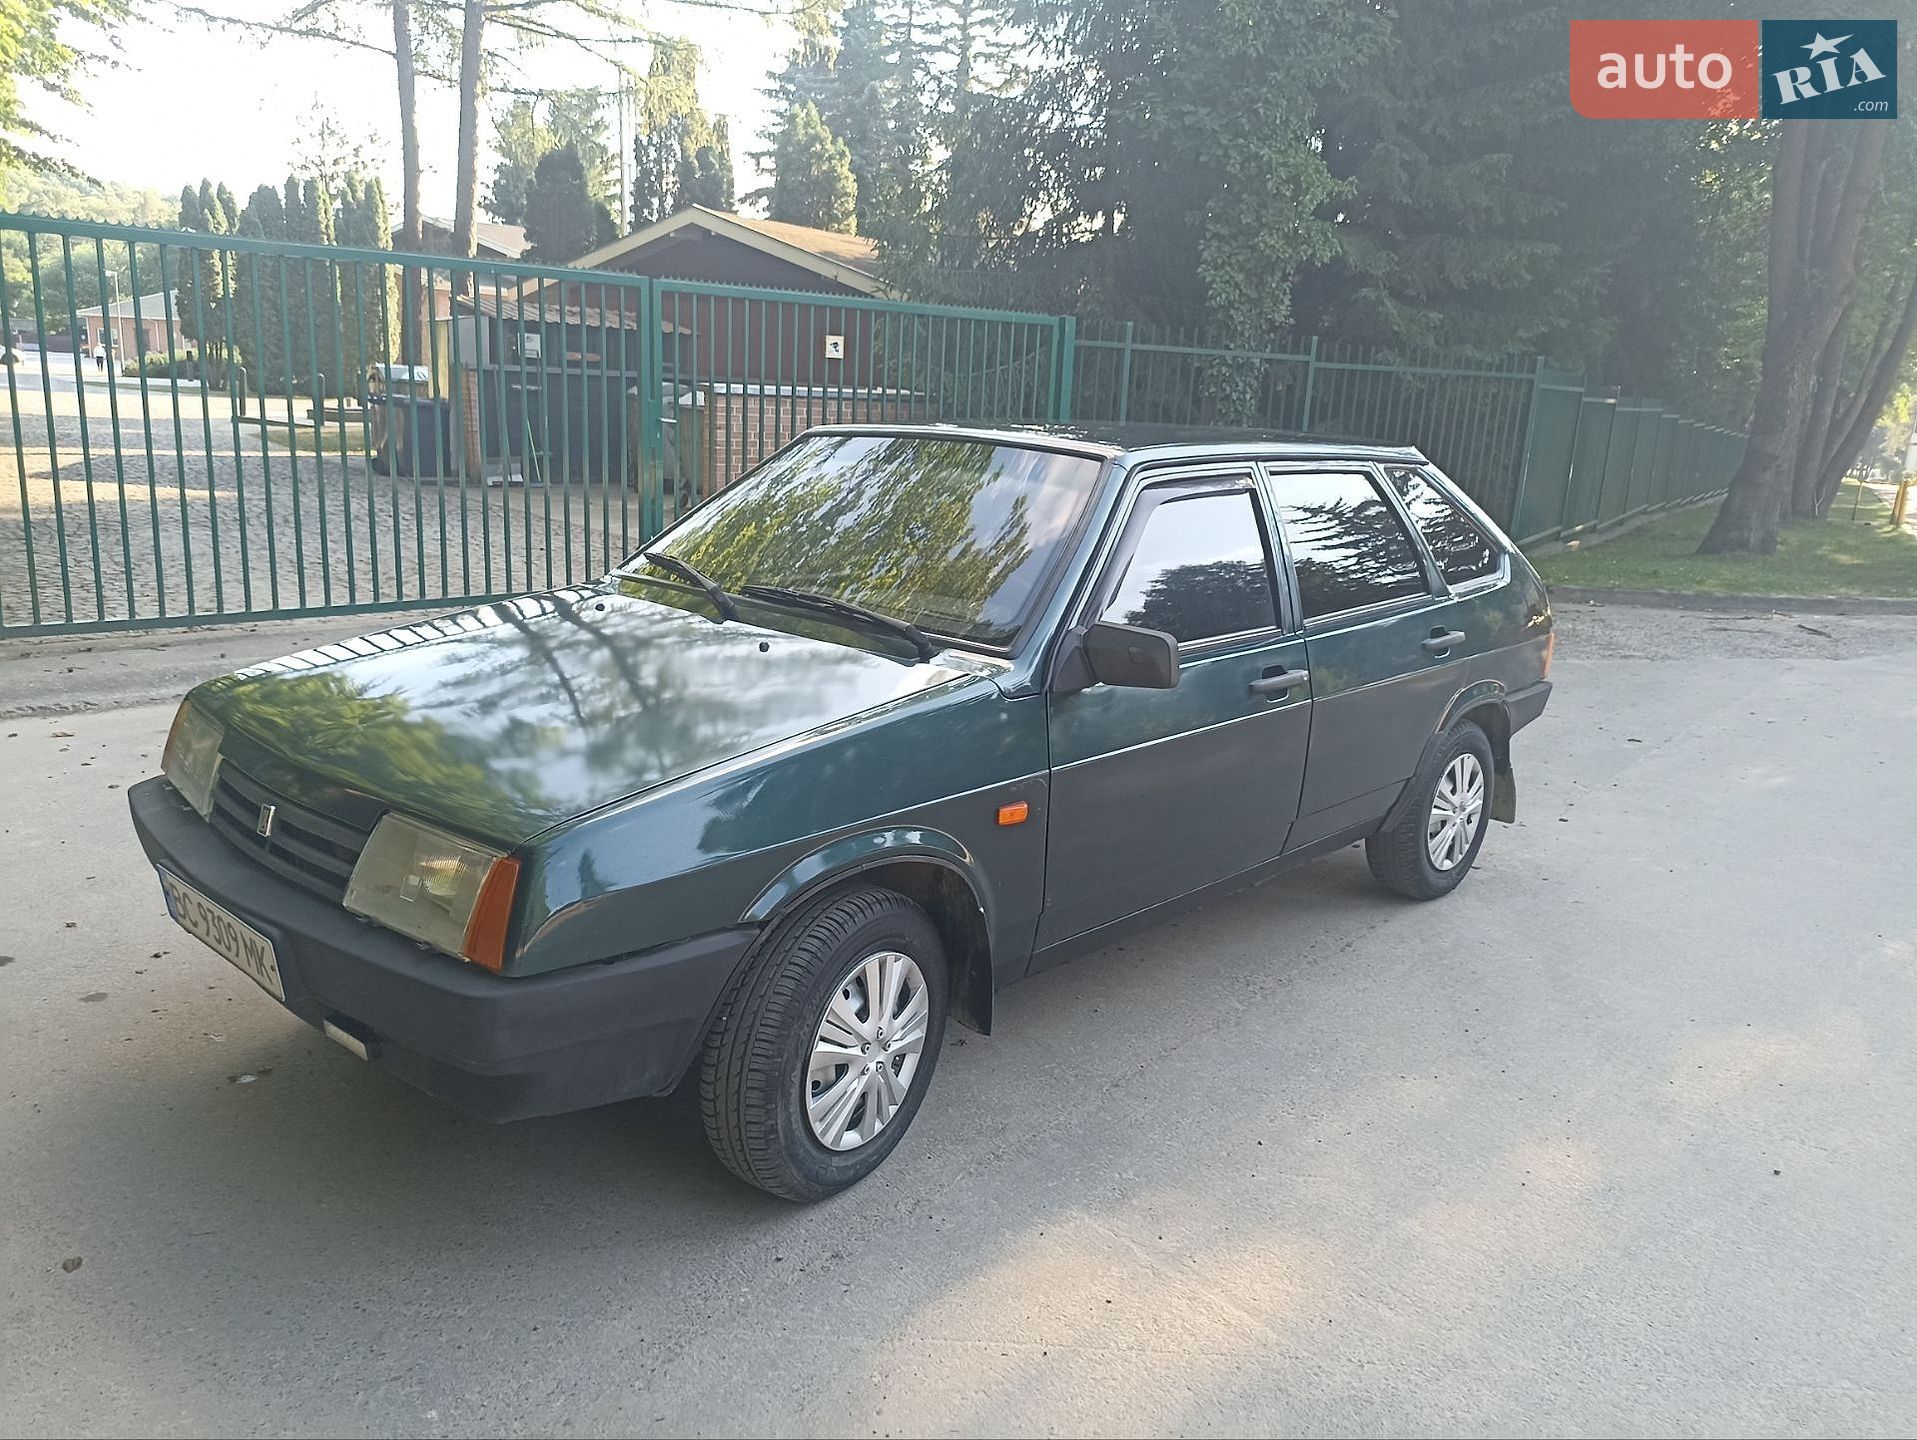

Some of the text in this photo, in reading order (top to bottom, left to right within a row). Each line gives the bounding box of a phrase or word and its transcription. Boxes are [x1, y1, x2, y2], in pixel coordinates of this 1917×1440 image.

[168, 881, 274, 985] BC 9309 MK
